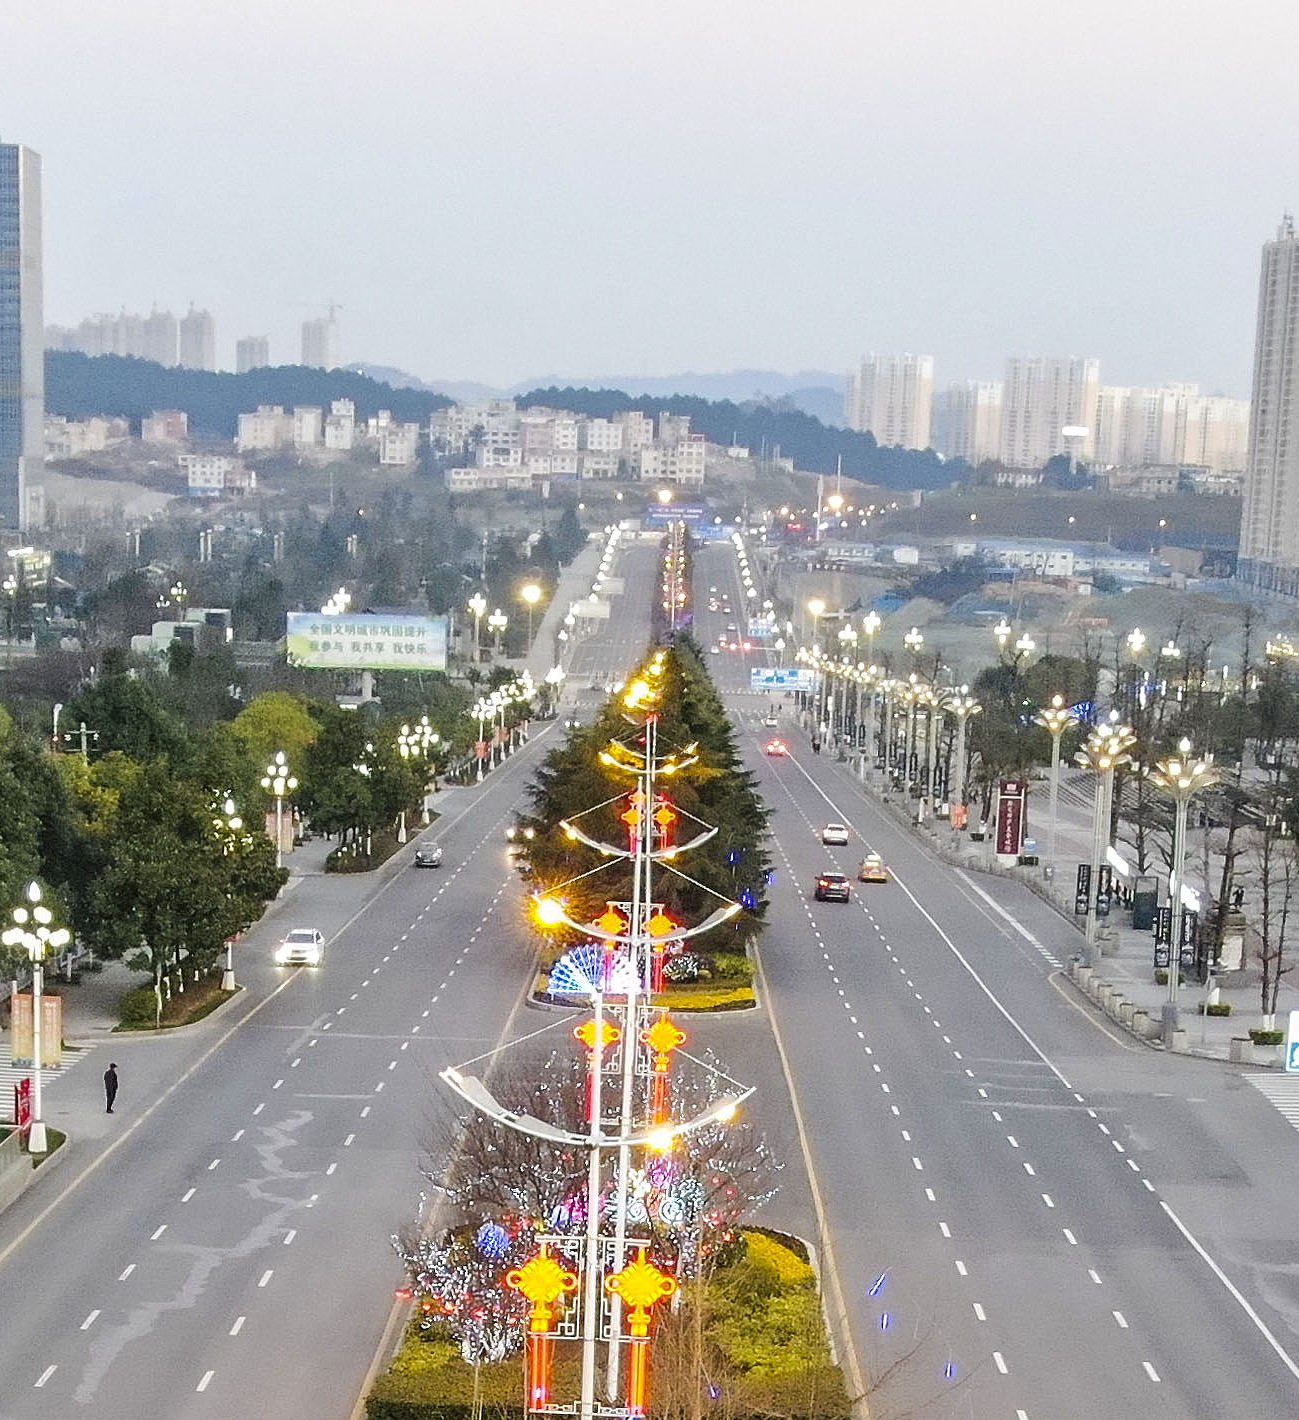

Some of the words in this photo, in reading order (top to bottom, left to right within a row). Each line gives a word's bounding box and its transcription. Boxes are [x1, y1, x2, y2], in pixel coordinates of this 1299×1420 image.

[309, 623, 428, 638] 全国文明城市巩固提升
[310, 641, 344, 653] 我参与
[351, 641, 385, 653] 我共享
[393, 642, 428, 654] 我快乐
